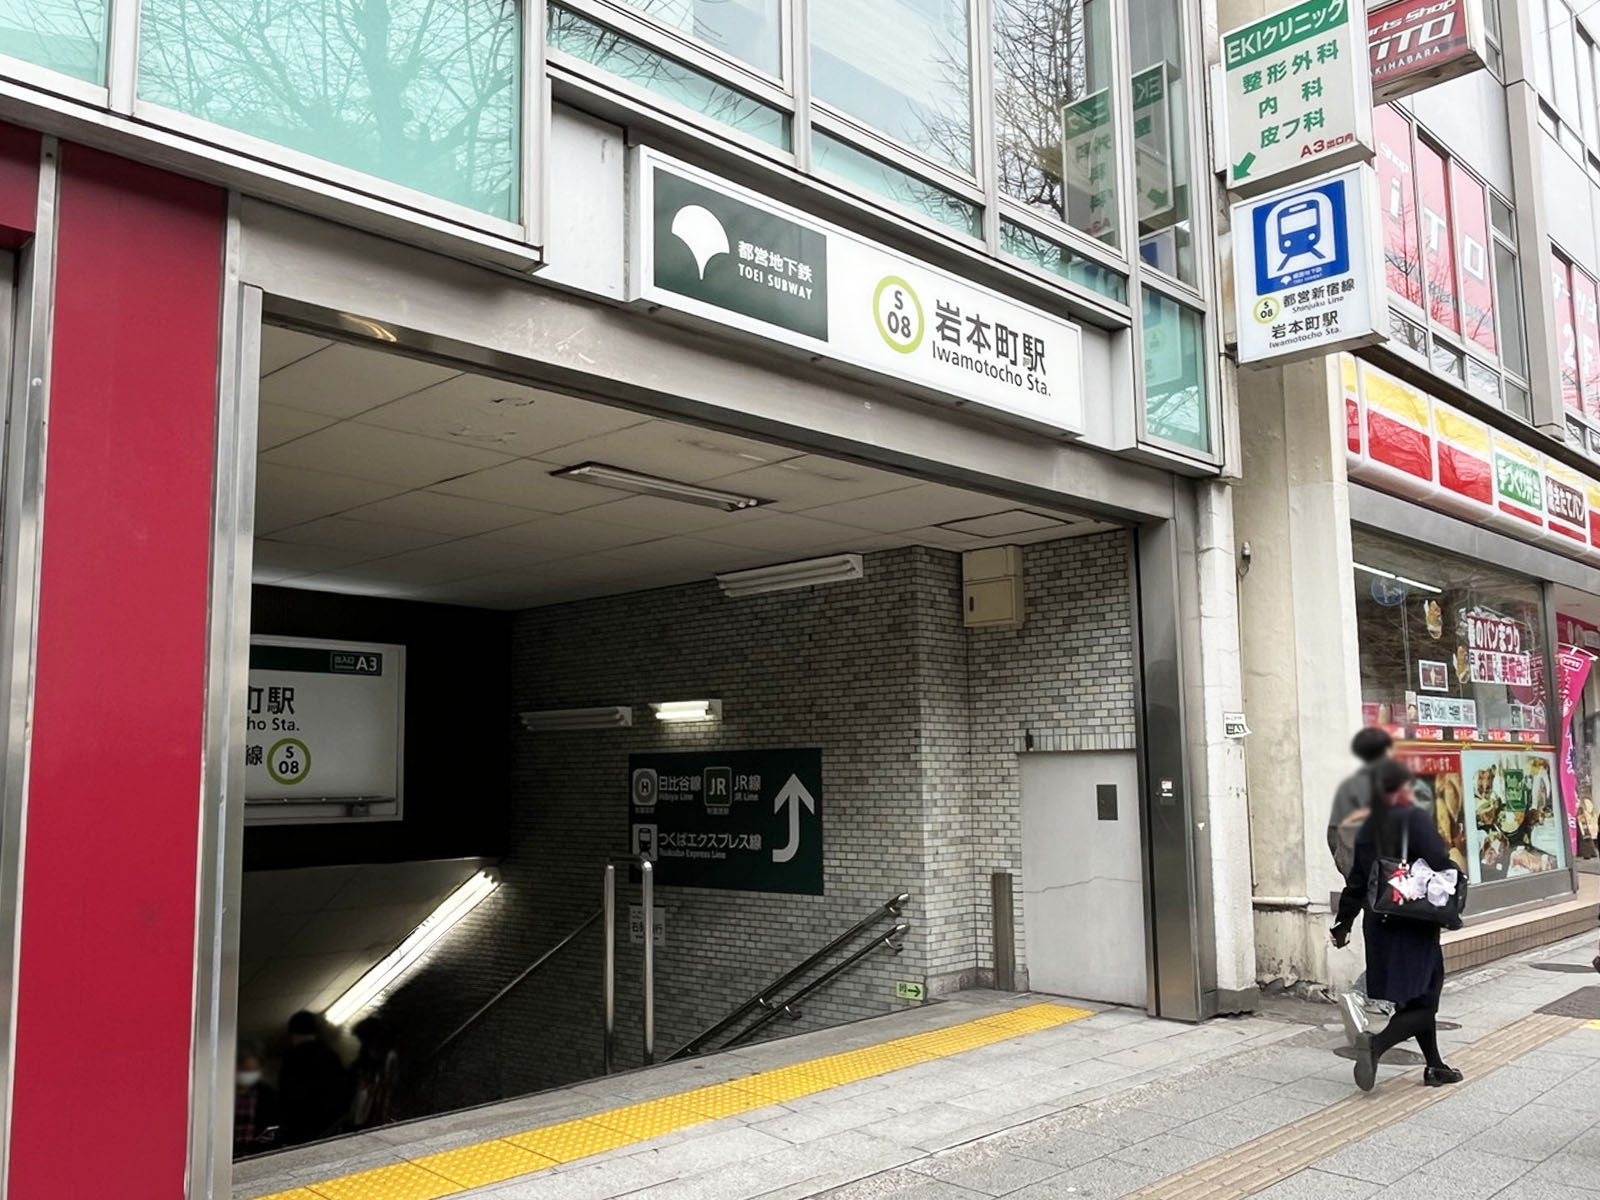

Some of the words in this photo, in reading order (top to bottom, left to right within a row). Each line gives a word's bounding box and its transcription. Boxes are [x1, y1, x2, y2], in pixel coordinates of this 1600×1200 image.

[1405, 0, 1456, 22] Shop
[1227, 0, 1345, 64] EKIクリニック
[1242, 39, 1339, 95] 整形外科
[1260, 107, 1326, 149] 皮フ科
[737, 240, 814, 283] 都営地下鉄
[738, 263, 765, 287] TOEI
[767, 273, 814, 301] SUBWAY
[893, 289, 904, 311] S
[1283, 279, 1355, 308] 都営新宿線
[1259, 308, 1274, 319] 08
[1263, 300, 1270, 309] S
[1292, 300, 1325, 314] Shinjuku
[1326, 295, 1345, 306] Line
[887, 314, 912, 340] 08
[1271, 310, 1339, 339] 岩本町駅
[934, 299, 1046, 376] 岩本町駅
[1269, 331, 1323, 349] Iwamotocho
[932, 340, 1022, 388] Iwamotocho
[1026, 372, 1052, 398] Sta.
[355, 655, 377, 672] A3
[272, 717, 300, 732] Sta.
[285, 745, 295, 759] S
[278, 760, 300, 774] 08
[658, 775, 702, 791] 日比谷線
[709, 777, 727, 796] JR
[733, 774, 762, 791] JR線
[658, 832, 762, 851] つくばエクスプレス線
